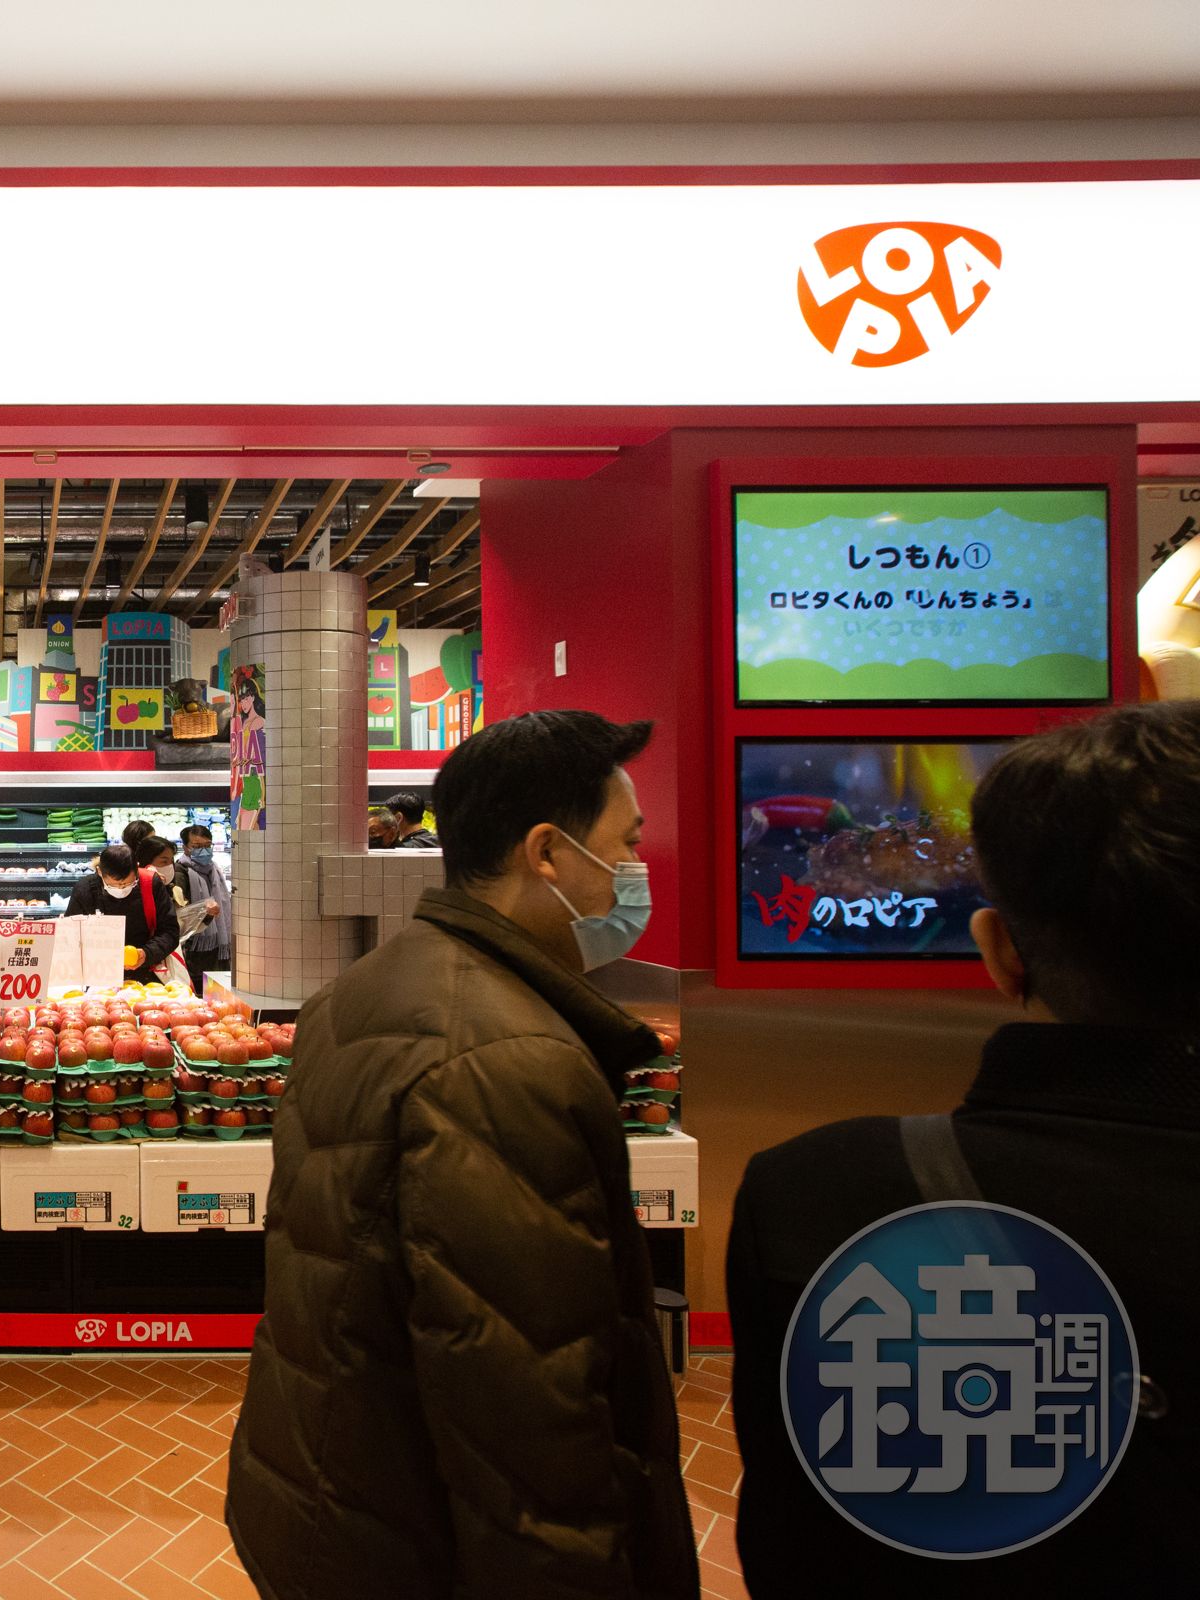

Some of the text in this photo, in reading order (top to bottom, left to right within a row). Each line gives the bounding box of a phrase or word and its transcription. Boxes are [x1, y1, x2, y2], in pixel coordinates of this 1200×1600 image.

[849, 542, 991, 570] しつもん①
[112, 620, 165, 636] LOPIA
[48, 640, 70, 648] ONION
[751, 873, 939, 943] 肉のロピア
[20, 924, 54, 934] お買得
[14, 948, 31, 956] 蘋果
[8, 957, 39, 966] 任選3個
[0, 973, 41, 1000] 200
[118, 1215, 133, 1229] 32
[681, 1210, 695, 1223] 32
[116, 1321, 193, 1342] LOPIA
